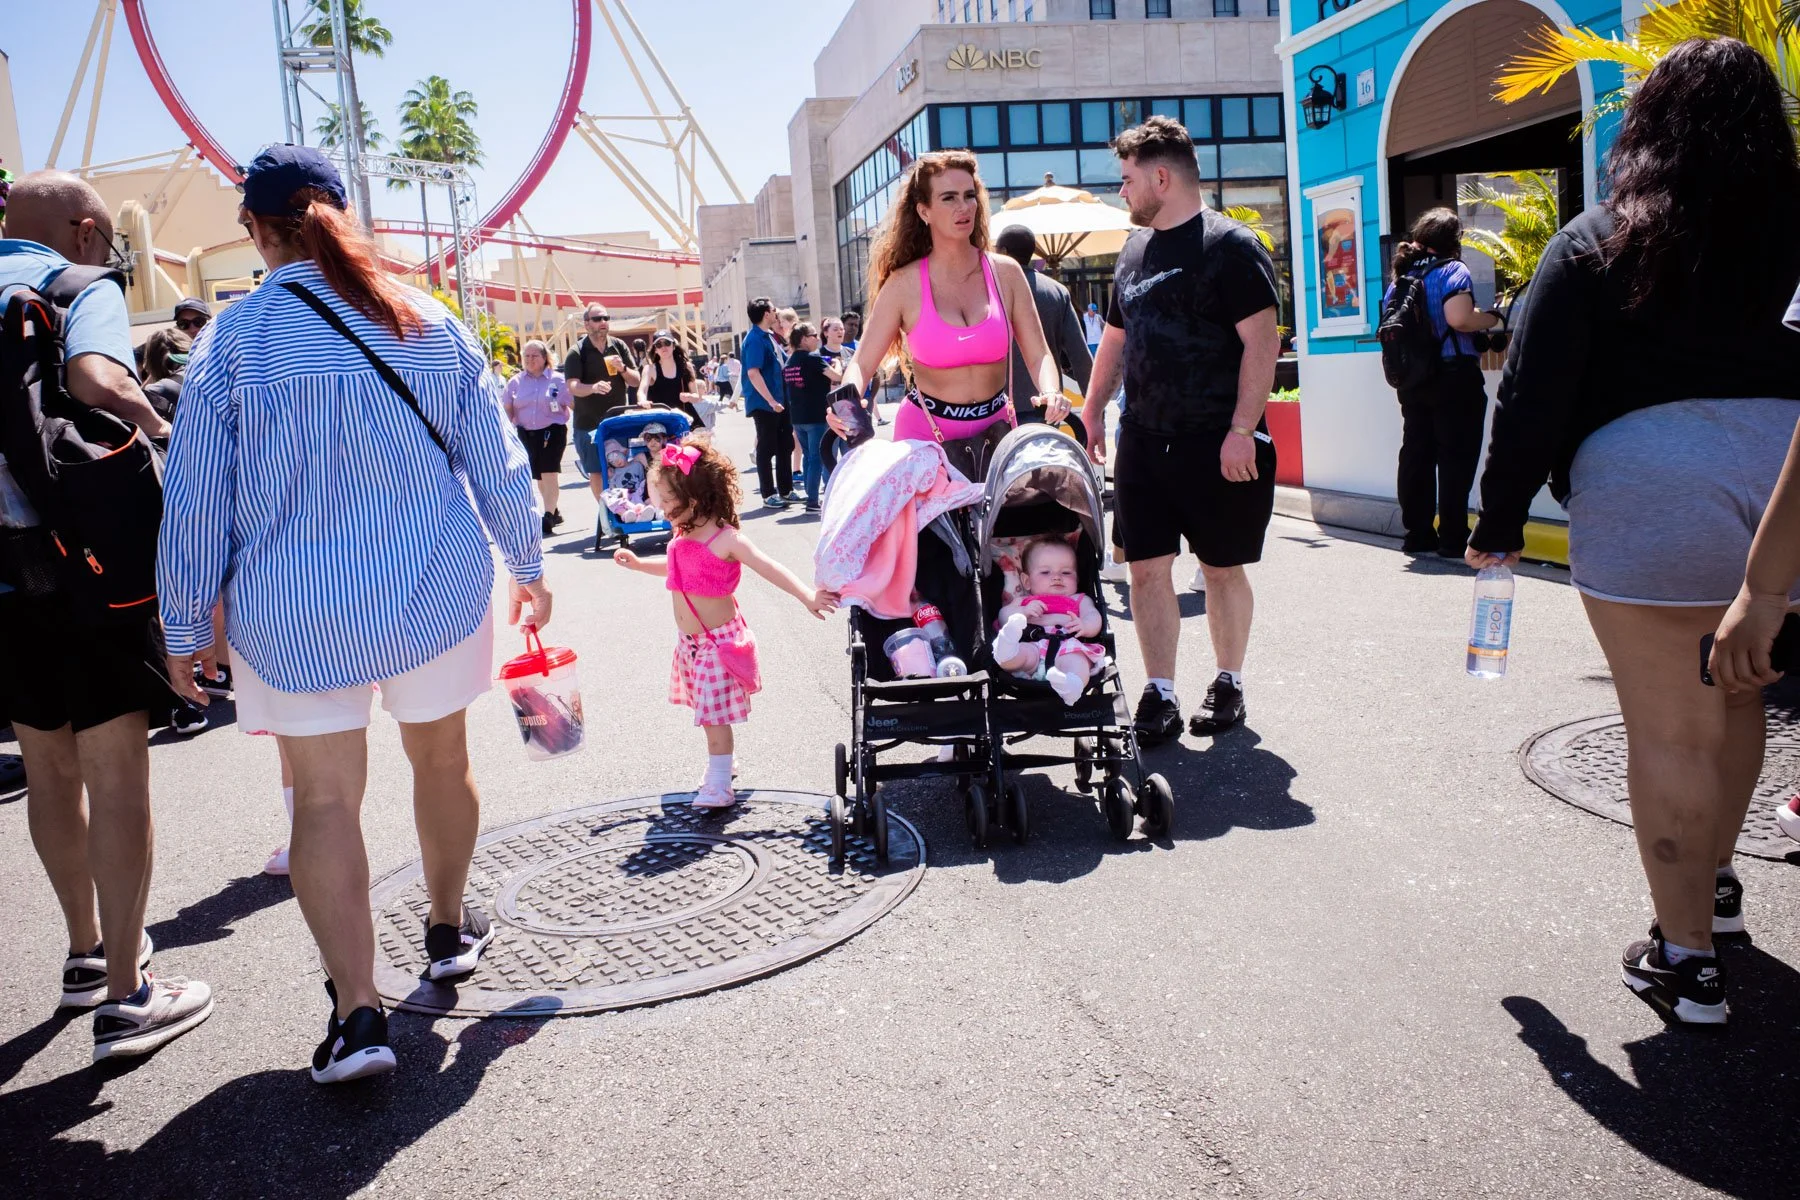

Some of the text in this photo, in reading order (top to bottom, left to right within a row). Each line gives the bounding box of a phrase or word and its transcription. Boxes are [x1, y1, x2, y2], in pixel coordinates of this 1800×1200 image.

[989, 49, 1043, 69] NBC
[1361, 80, 1371, 95] 16
[943, 404, 990, 418] NIKE
[867, 716, 898, 727] Jeep
[1718, 886, 1733, 894] NIKE
[1701, 967, 1717, 976] NIKE
